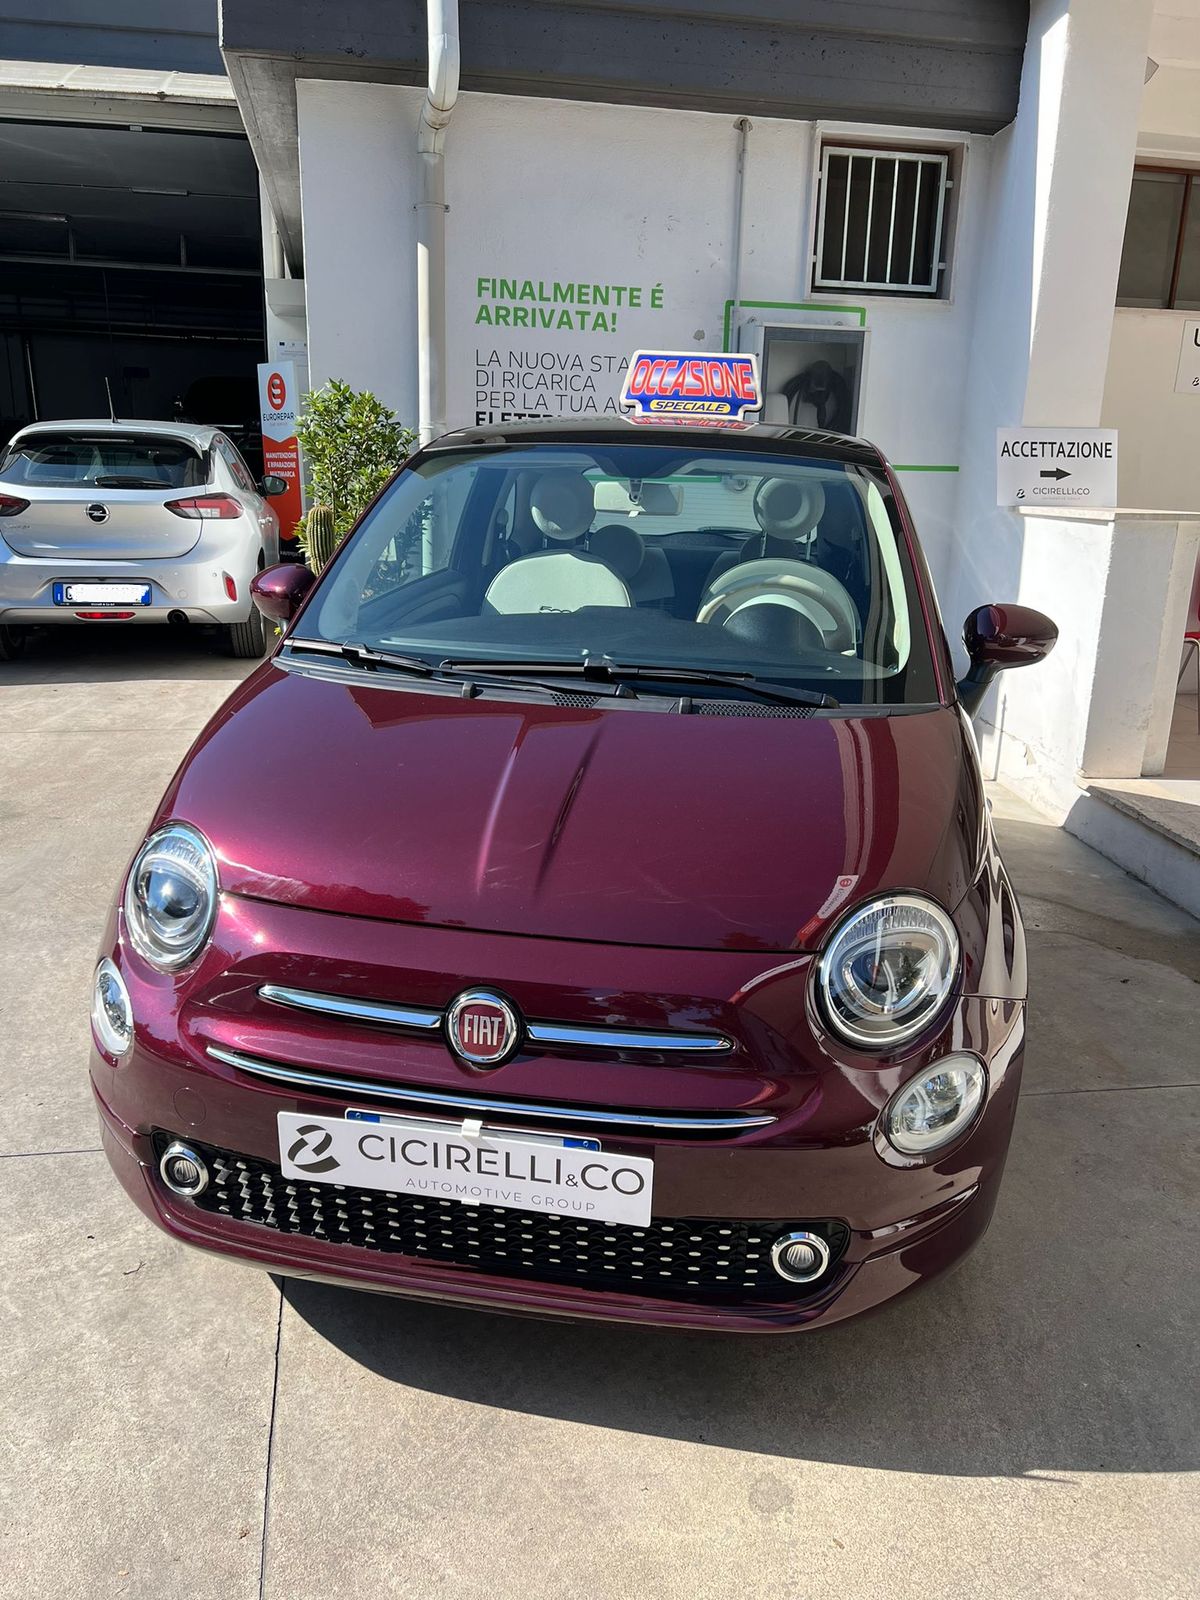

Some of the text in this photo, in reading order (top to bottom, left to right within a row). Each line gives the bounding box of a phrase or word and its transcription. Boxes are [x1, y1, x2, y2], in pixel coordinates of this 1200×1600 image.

[477, 277, 664, 309] FINALMENTE É
[475, 304, 617, 333] ARRIVATA!
[475, 349, 501, 368] LA
[509, 351, 584, 371] NUOVA
[475, 370, 596, 392] DI RICARICA
[630, 359, 756, 400] OCCASIONE
[475, 391, 516, 409] PER
[523, 393, 548, 410] LA
[555, 394, 598, 413] TUA
[653, 400, 728, 412] SPECIALE
[263, 412, 295, 421] EUROREPAR
[1001, 441, 1113, 458] ACCETTAZIONE
[464, 1013, 502, 1046] FIAT
[405, 1177, 596, 1212] AUTOMOTIVE GROUP
